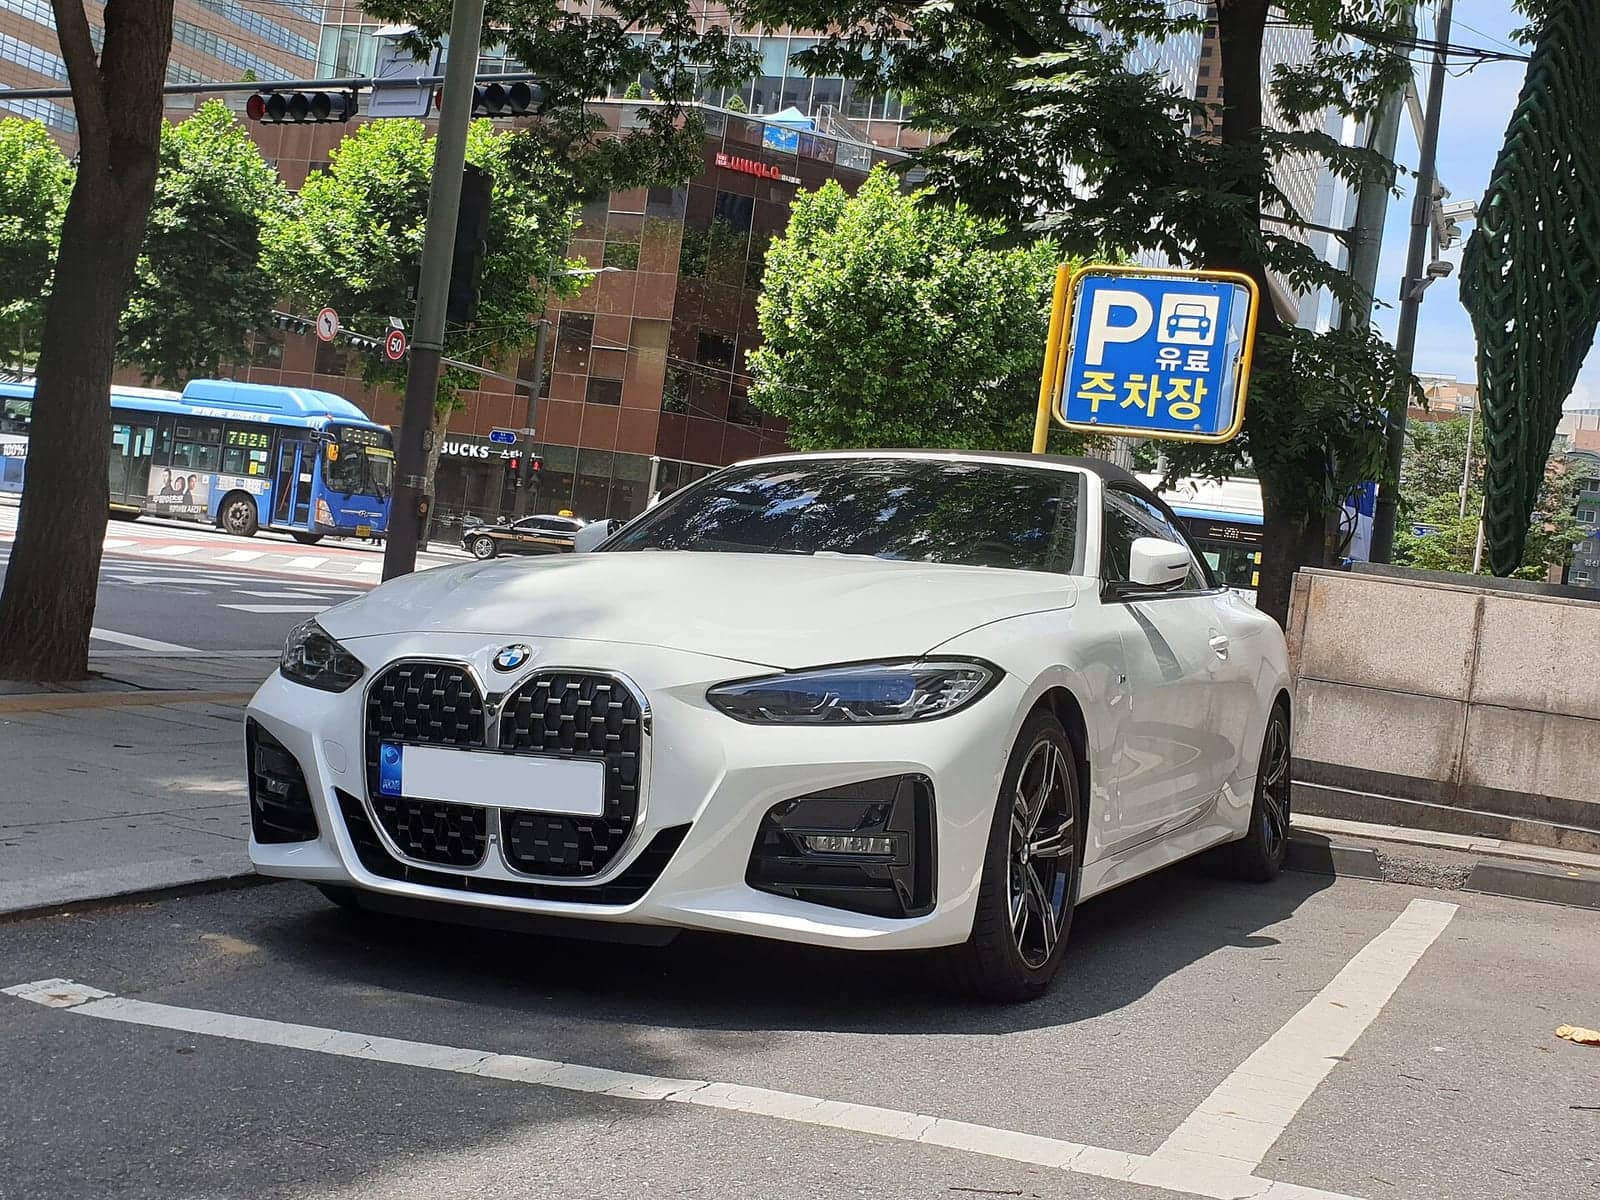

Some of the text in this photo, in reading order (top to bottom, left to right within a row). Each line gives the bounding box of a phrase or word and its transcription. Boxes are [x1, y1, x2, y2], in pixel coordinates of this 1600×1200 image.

[731, 155, 779, 178] UNIQLO
[1085, 289, 1154, 366] P
[390, 337, 402, 352] 50
[1155, 347, 1210, 373] 유료
[1076, 371, 1209, 421] 주차장
[228, 431, 269, 448] 702A
